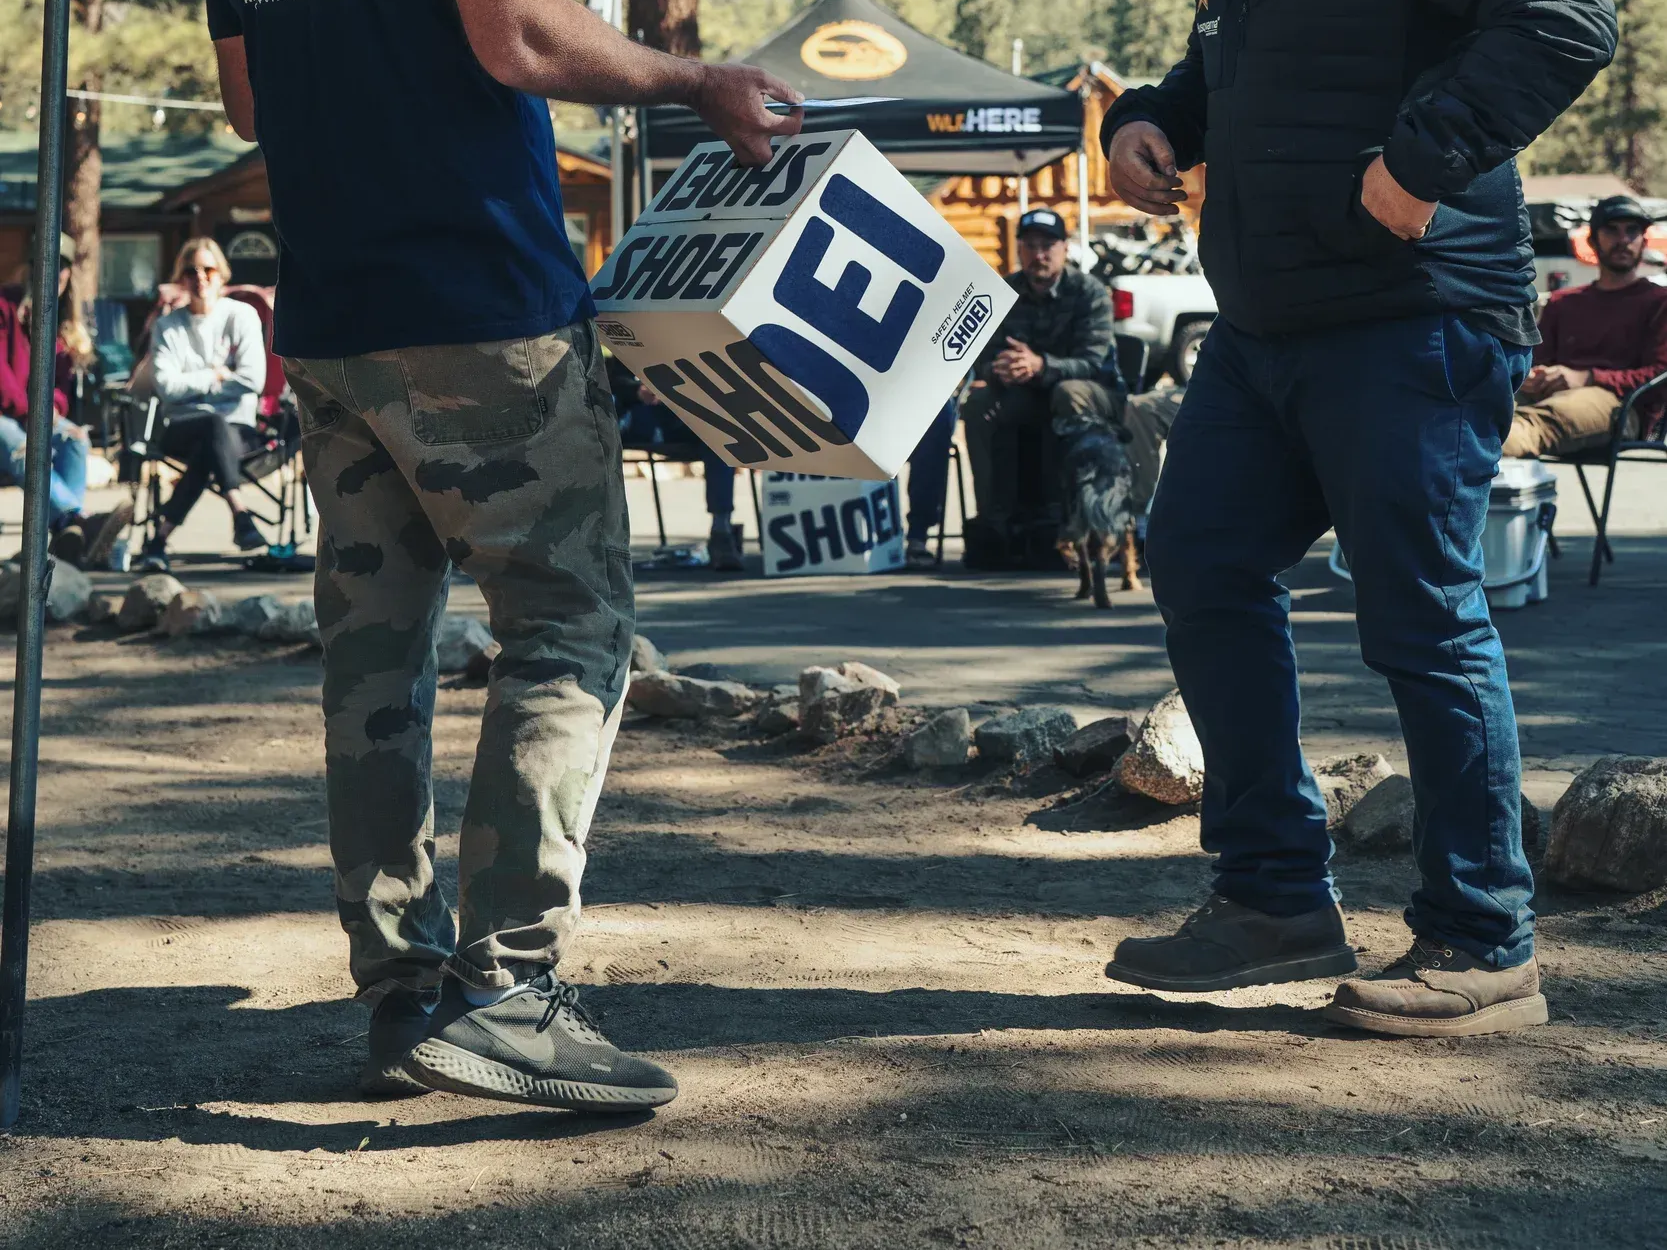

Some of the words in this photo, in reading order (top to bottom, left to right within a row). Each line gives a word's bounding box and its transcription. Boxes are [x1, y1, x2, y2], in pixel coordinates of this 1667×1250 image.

[654, 142, 832, 213] SHOEI
[591, 232, 764, 300] SHOEI
[931, 313, 953, 345] SAFETY
[952, 282, 976, 314] HELMET
[947, 299, 989, 355] SHOEI
[768, 481, 900, 573] SHOEI
